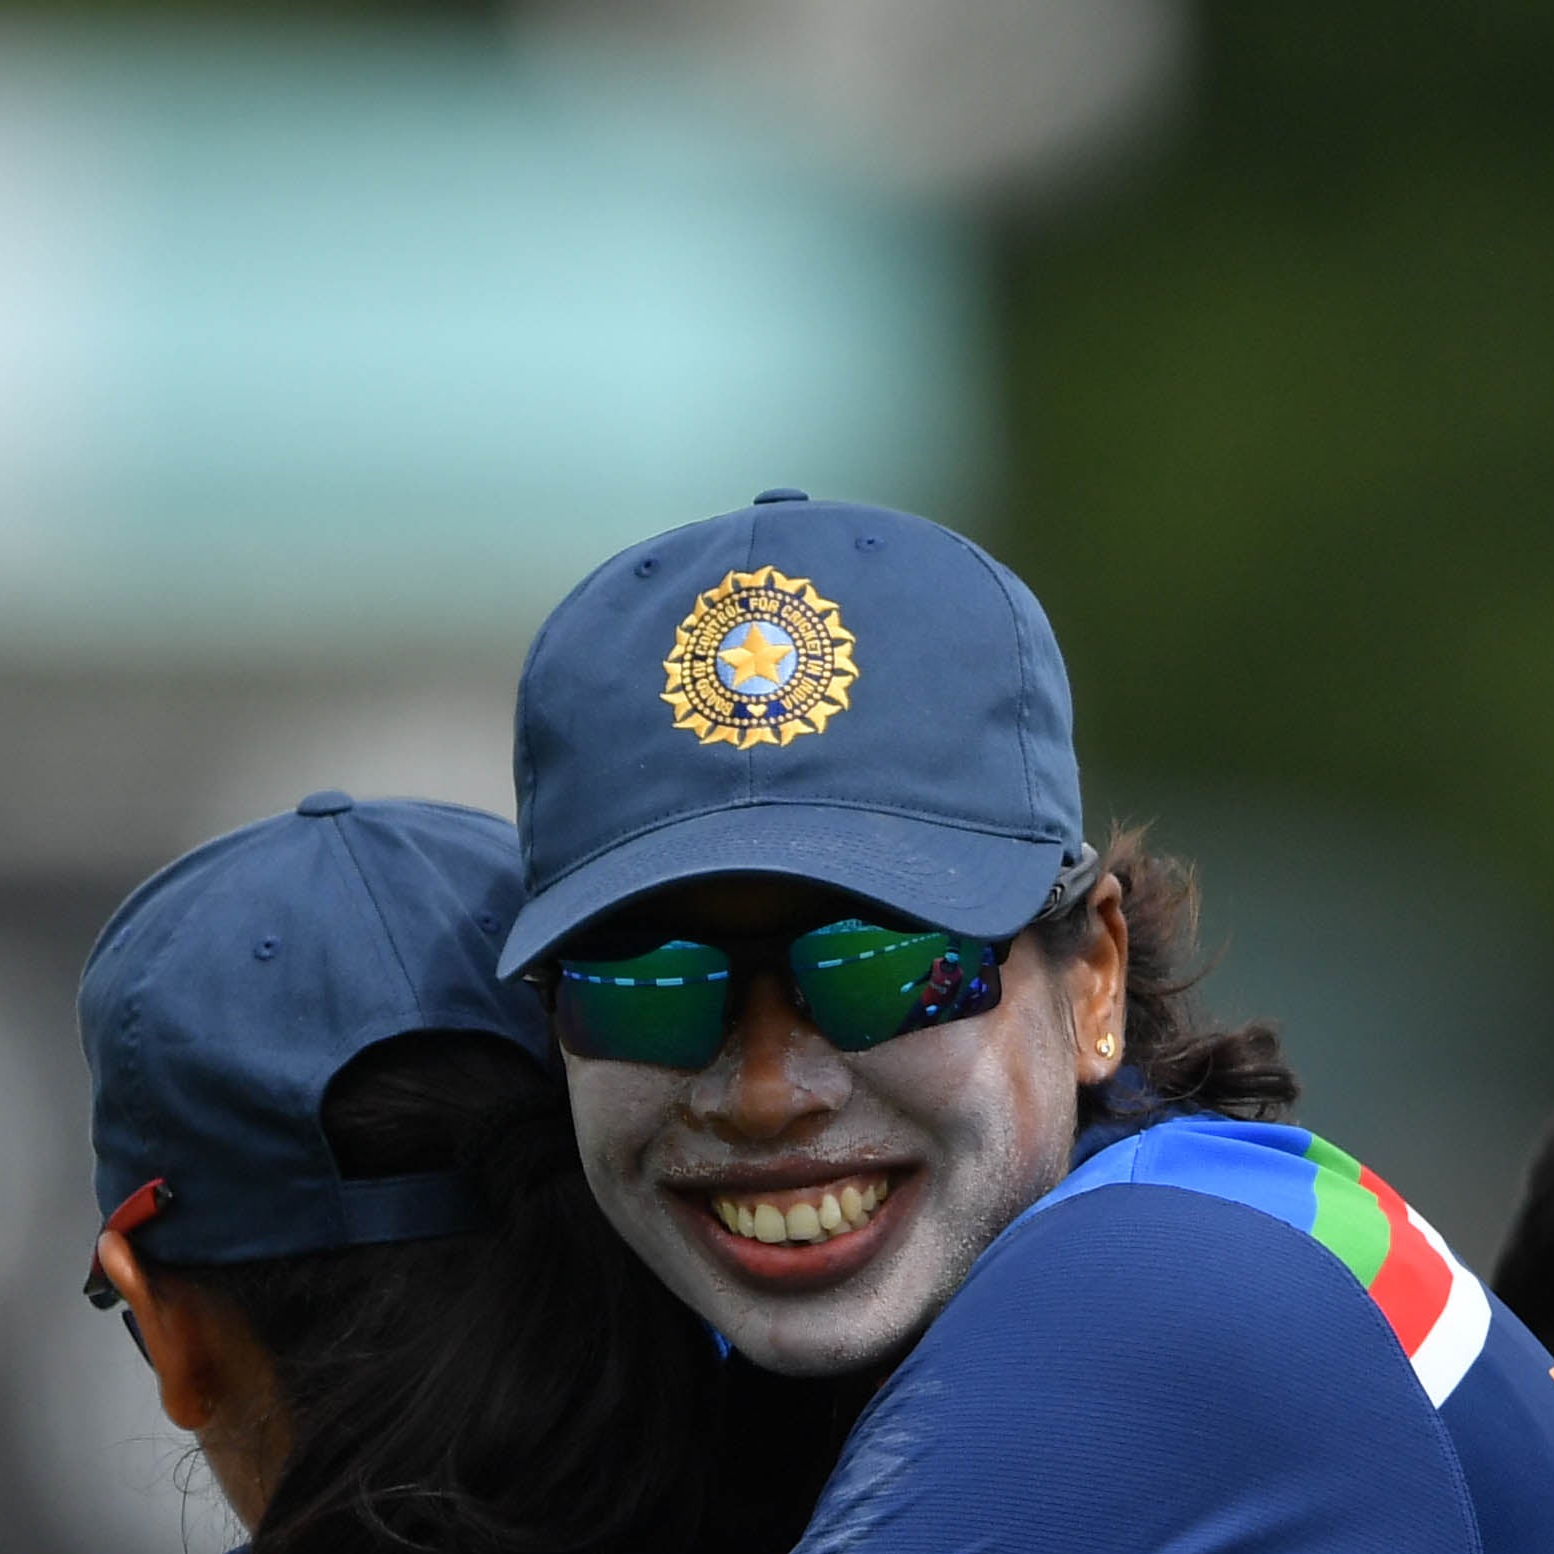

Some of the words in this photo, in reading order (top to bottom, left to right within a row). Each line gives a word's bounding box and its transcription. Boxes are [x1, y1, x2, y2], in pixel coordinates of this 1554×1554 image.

[694, 602, 746, 656] CONTROL
[749, 597, 779, 612] FOR
[781, 604, 822, 656] CRICKET
[806, 660, 824, 676] IN
